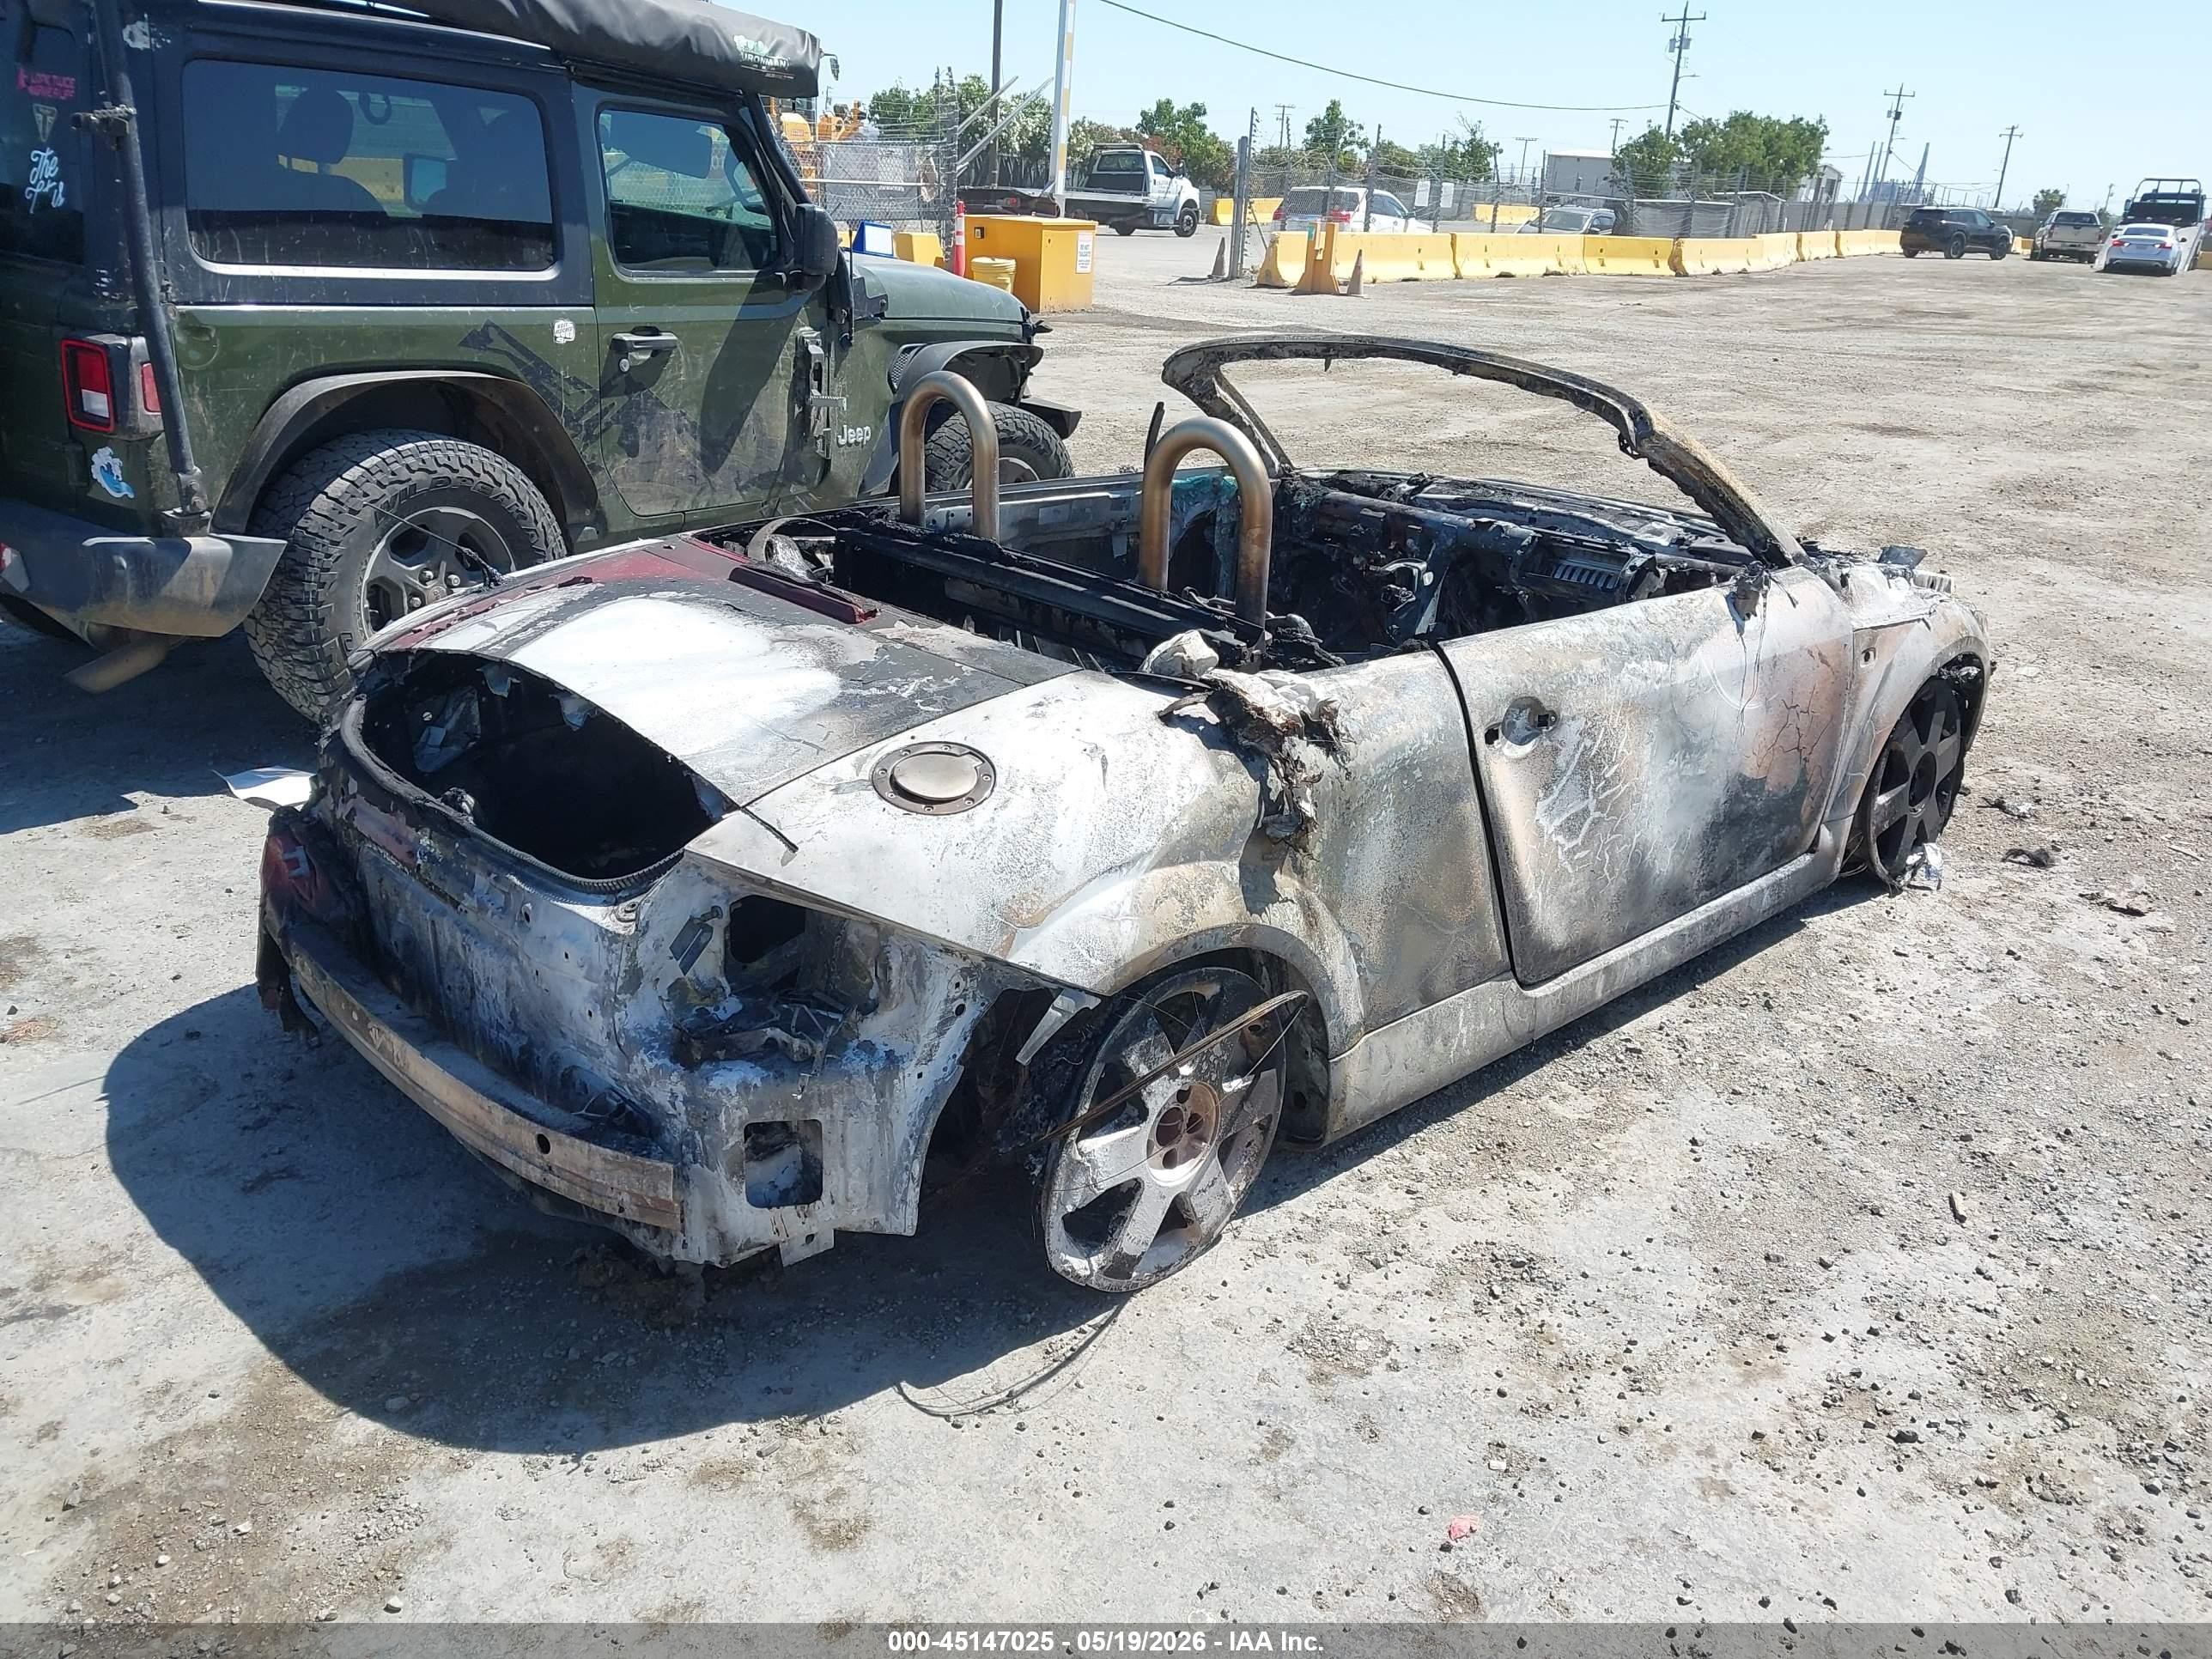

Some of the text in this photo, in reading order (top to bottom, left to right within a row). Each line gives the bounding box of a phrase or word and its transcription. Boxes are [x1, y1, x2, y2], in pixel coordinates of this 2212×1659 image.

[744, 53, 787, 68] IRONMAN
[29, 147, 58, 185] The
[836, 424, 871, 446] Jeep
